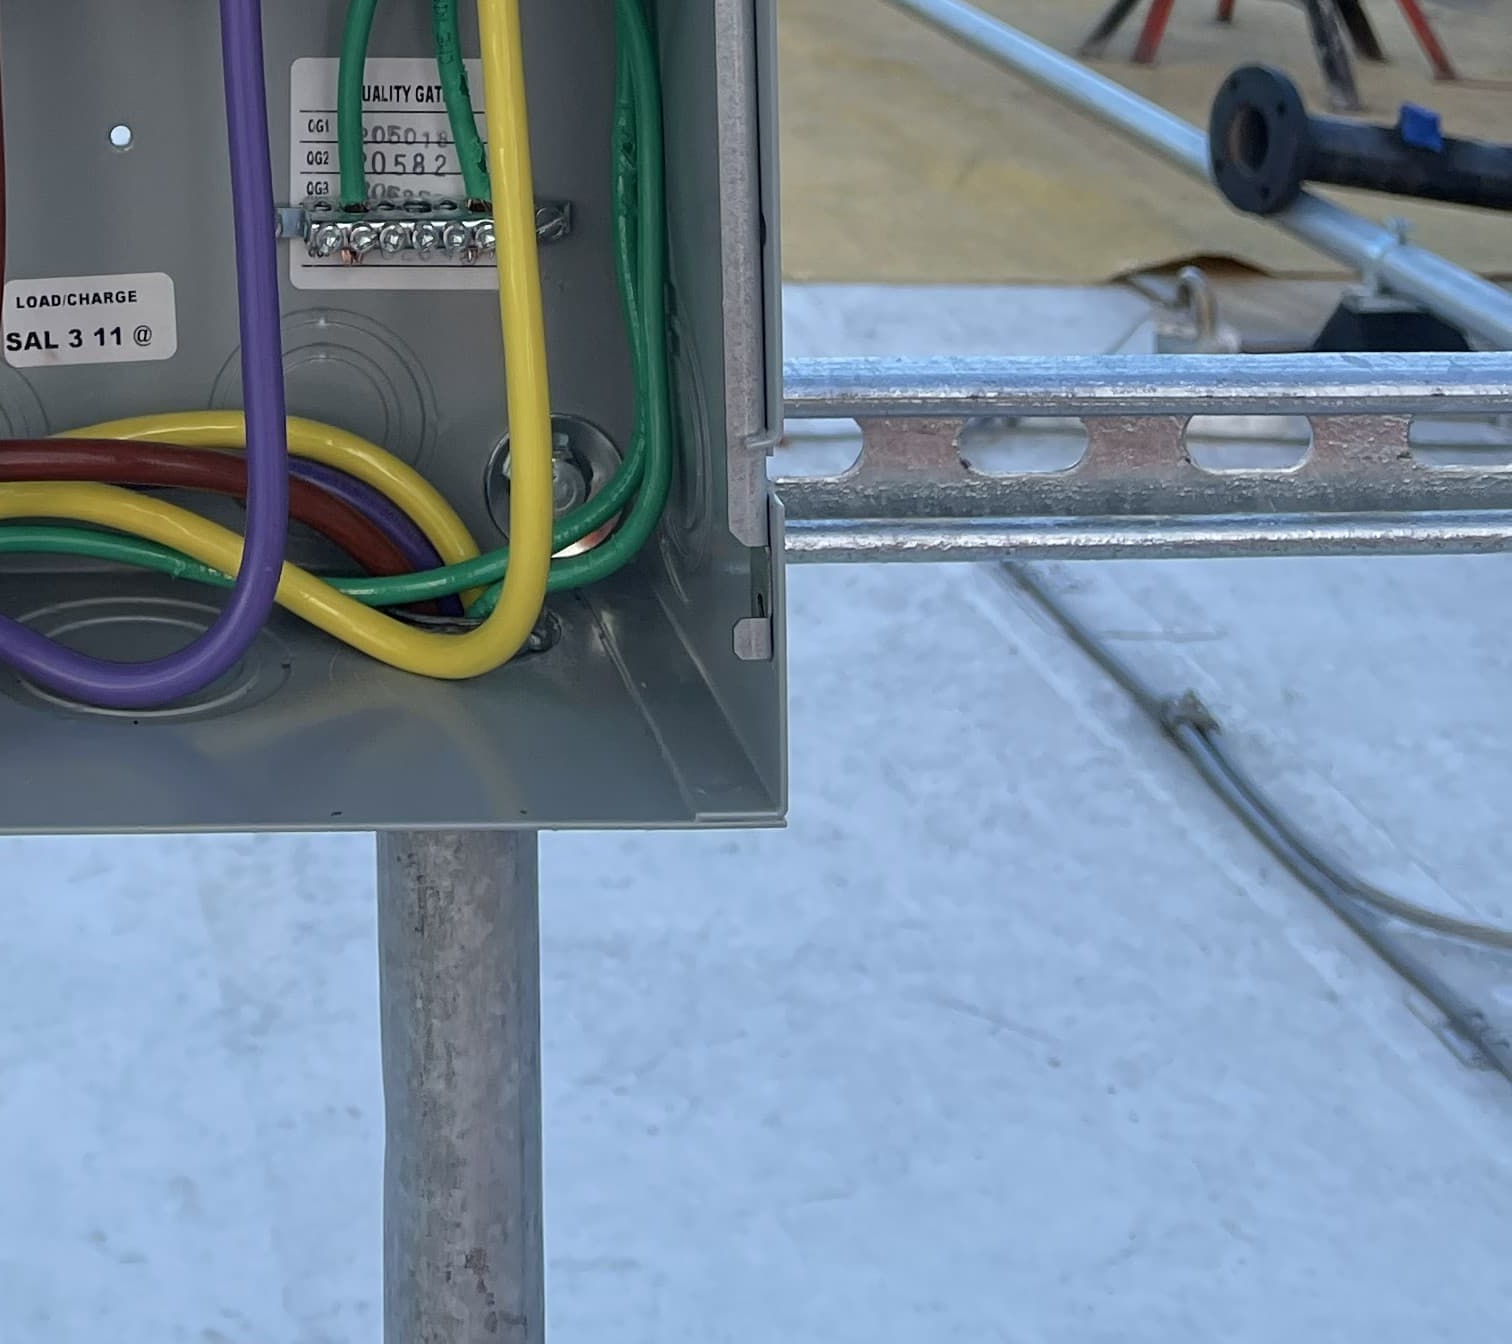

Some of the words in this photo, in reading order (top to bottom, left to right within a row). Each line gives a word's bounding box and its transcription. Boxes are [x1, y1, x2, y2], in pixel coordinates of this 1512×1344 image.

[362, 84, 412, 103] UALITY
[415, 84, 445, 103] GAT
[363, 124, 449, 149] 05018
[306, 150, 329, 166] QG2
[363, 150, 447, 176] 0582
[306, 180, 329, 196] QG3
[15, 289, 138, 310] LOAD/CHARGE
[5, 330, 59, 352] SAL
[68, 328, 83, 349] 3
[93, 326, 123, 347] 11
[133, 324, 152, 347] @
